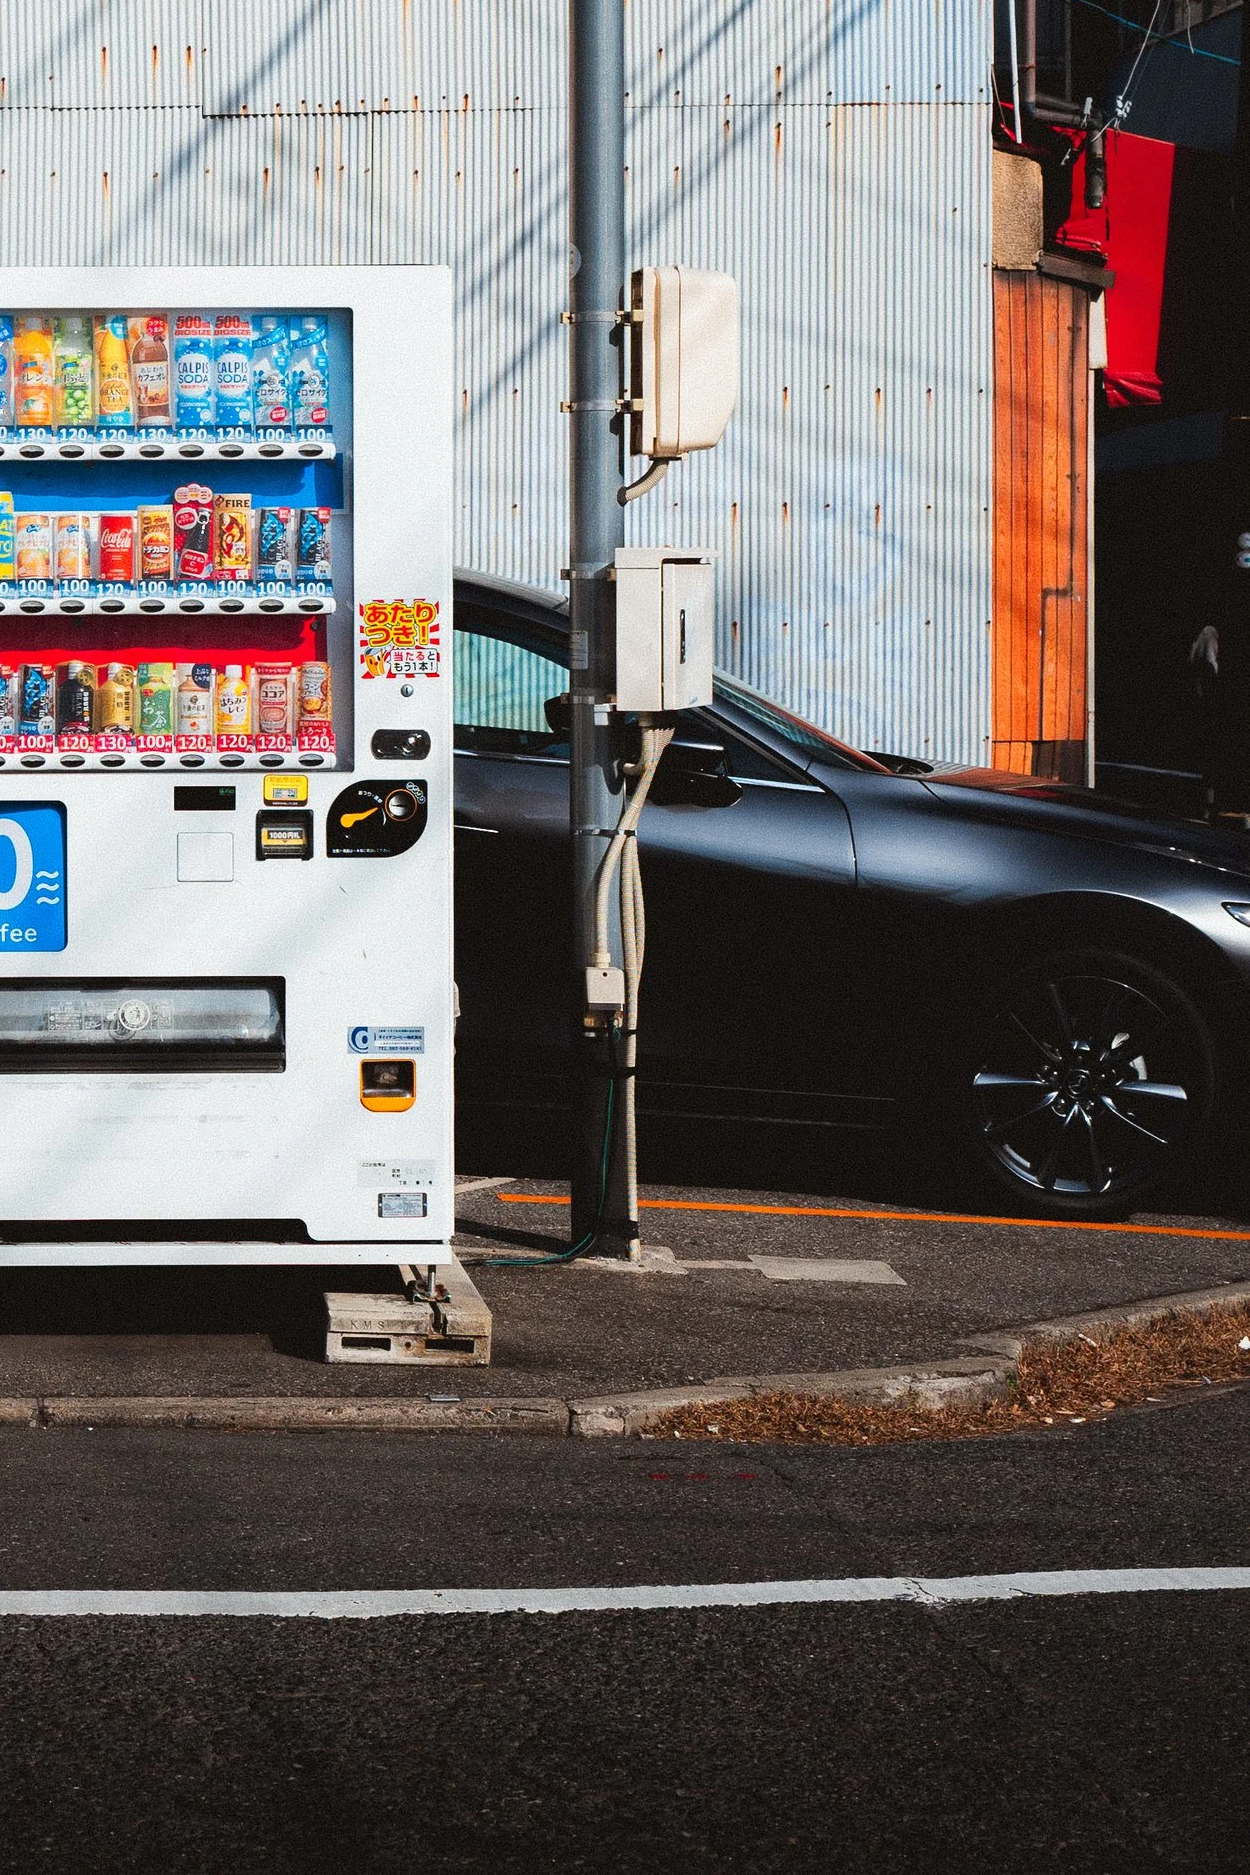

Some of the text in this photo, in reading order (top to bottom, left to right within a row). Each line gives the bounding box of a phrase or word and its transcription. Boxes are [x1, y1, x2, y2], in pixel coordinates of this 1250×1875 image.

[225, 499, 250, 508] FIRE
[365, 603, 435, 624] あたり
[393, 651, 435, 661] 当たると
[394, 661, 434, 672] もう1本!
[262, 690, 285, 698] ココア
